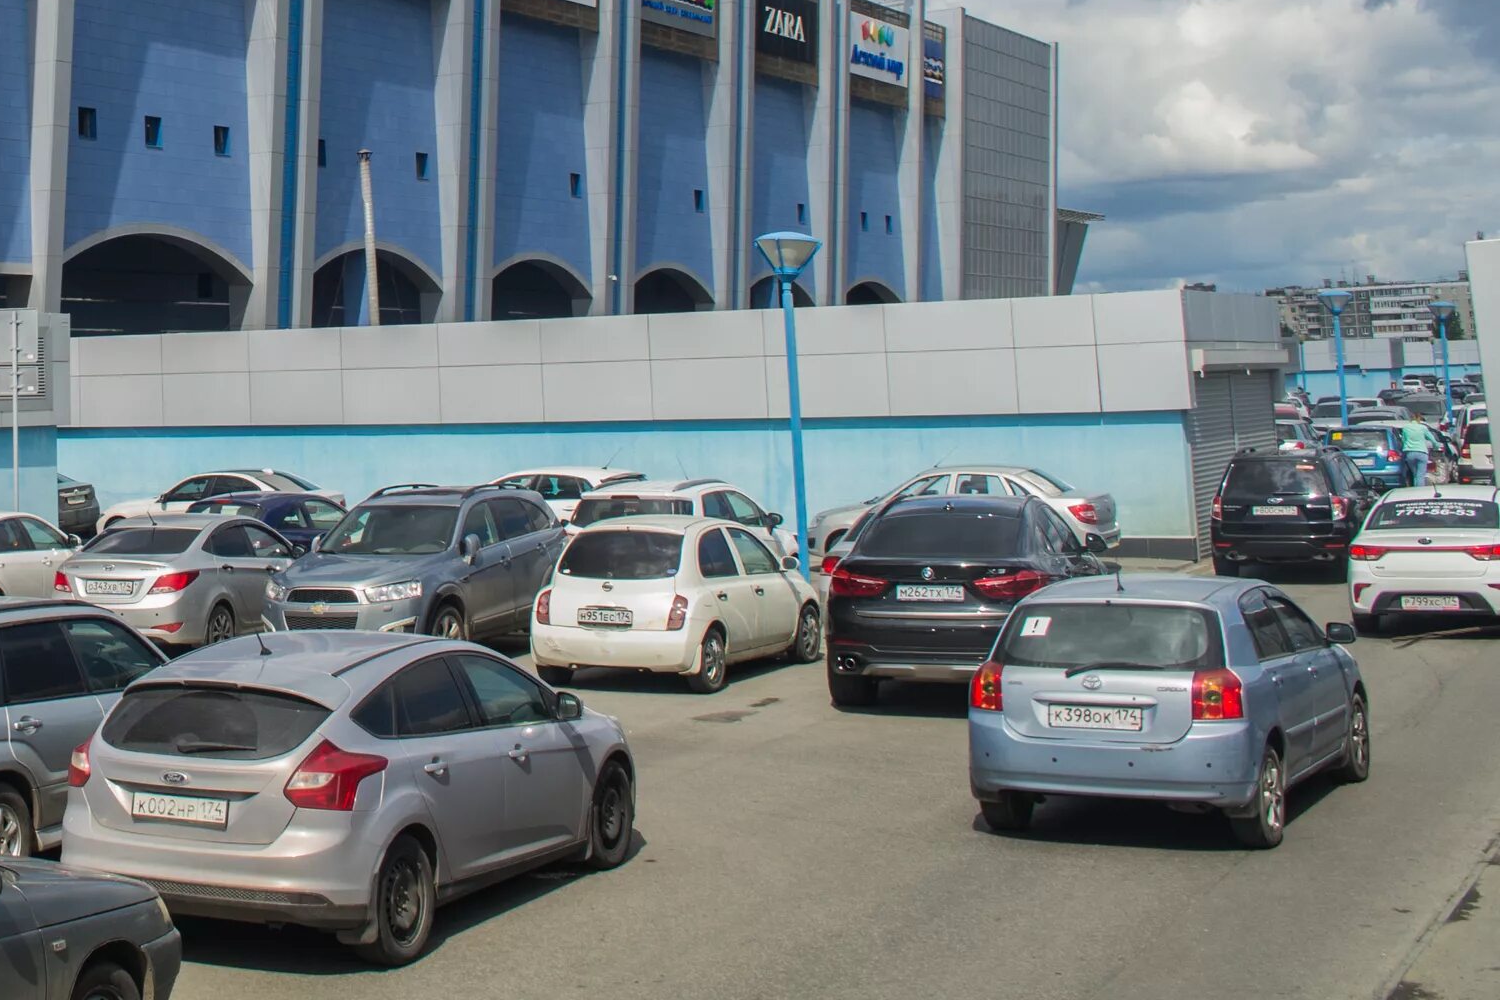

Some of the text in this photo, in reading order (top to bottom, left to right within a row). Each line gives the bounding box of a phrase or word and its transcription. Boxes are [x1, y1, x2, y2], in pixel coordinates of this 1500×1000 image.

[764, 6, 806, 43] ZARA
[899, 586, 961, 598] М262ТХ 174
[580, 611, 615, 622] Н951ЕС
[1054, 707, 1137, 724] К398ОК 174
[138, 797, 222, 818] К002НР 174
